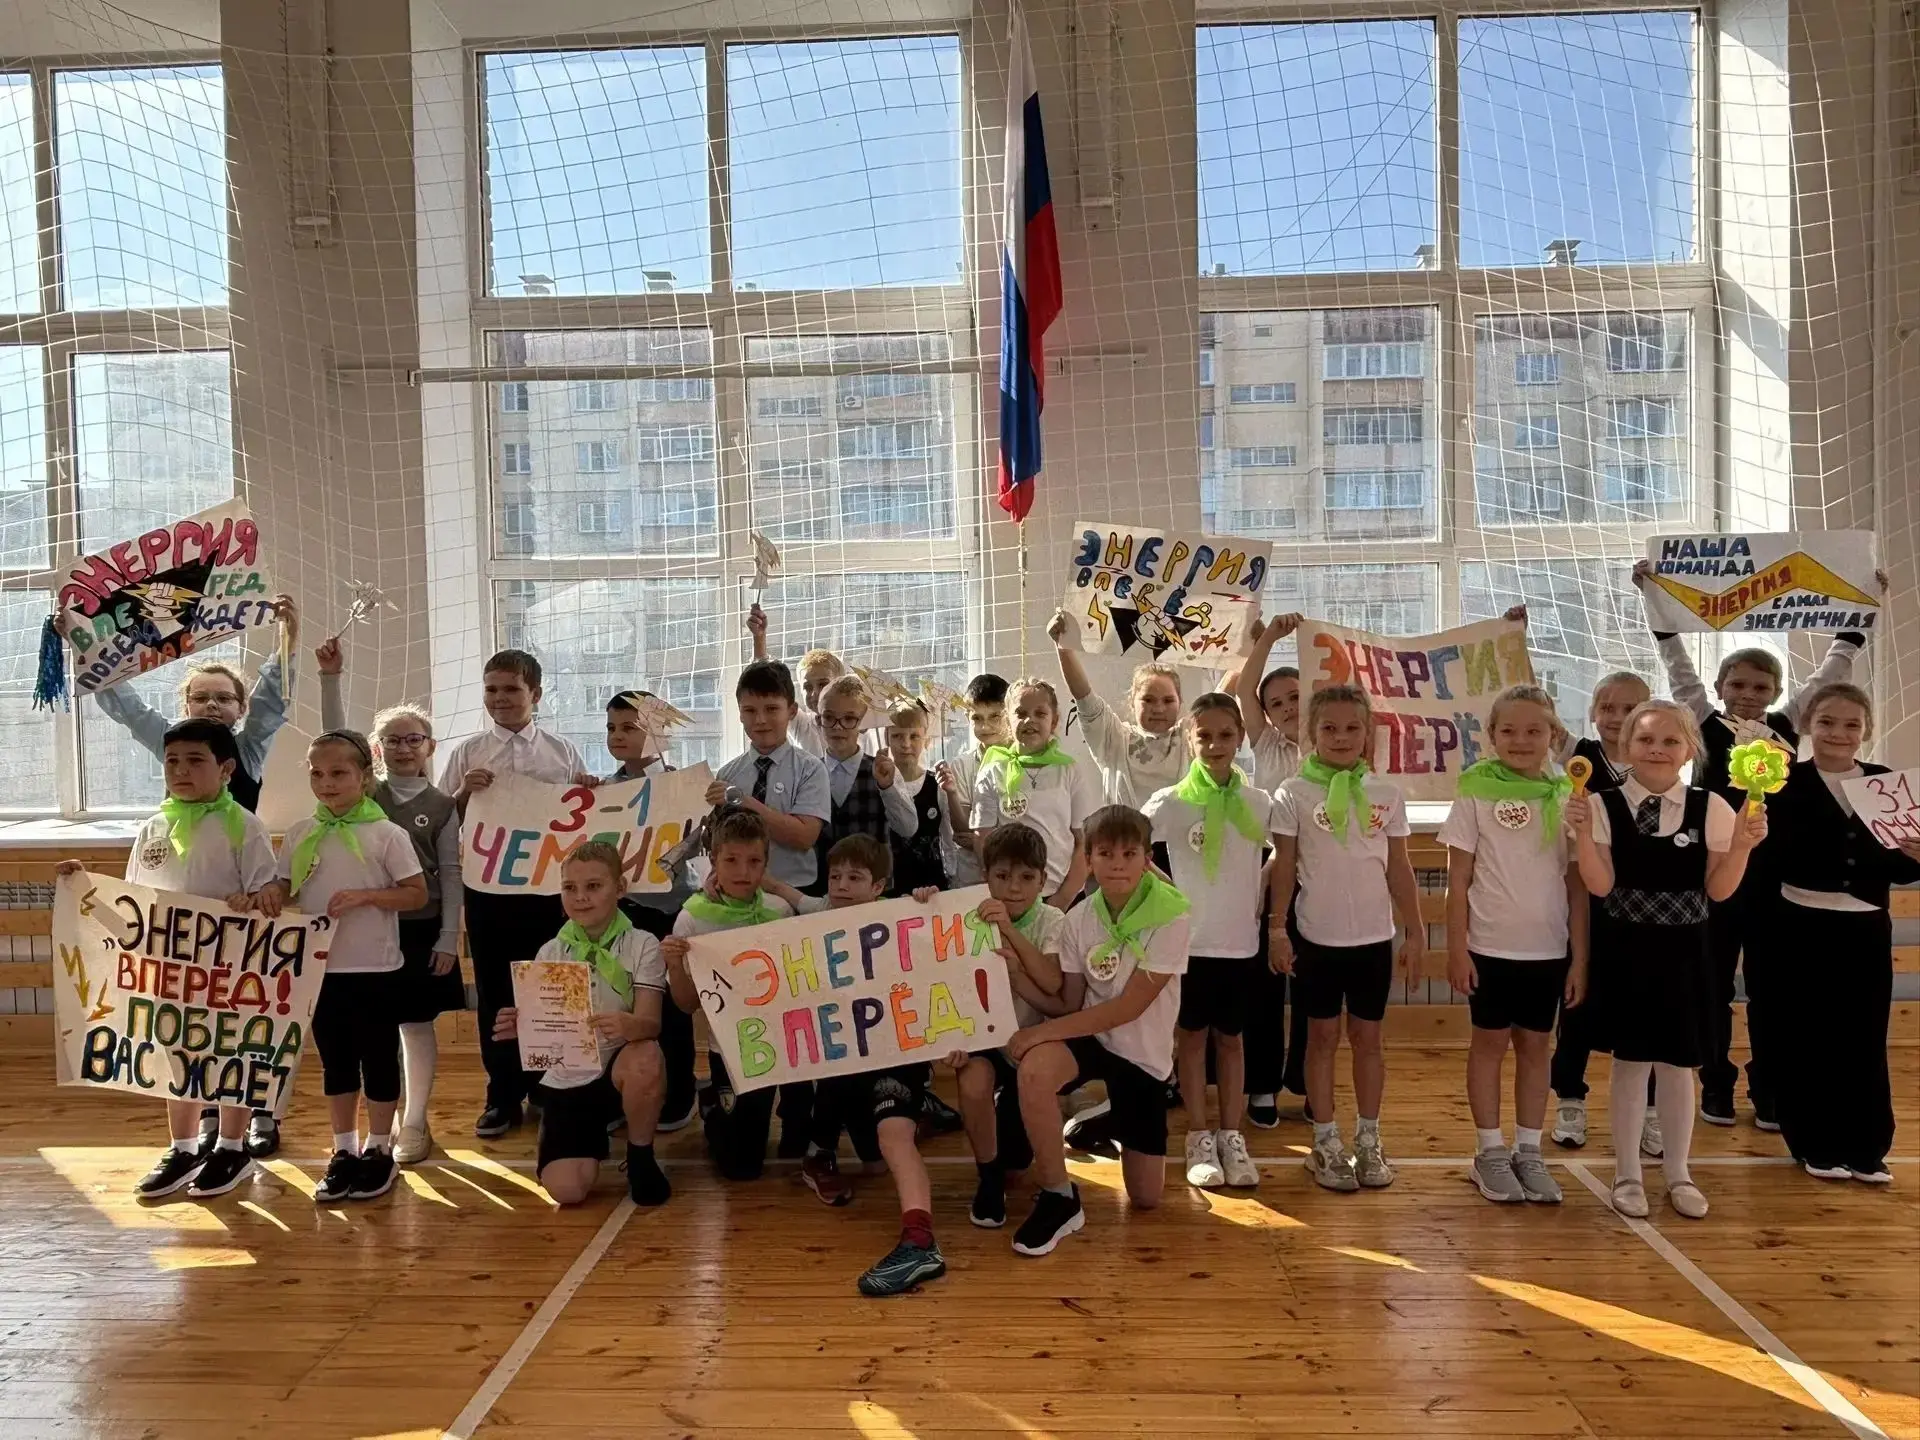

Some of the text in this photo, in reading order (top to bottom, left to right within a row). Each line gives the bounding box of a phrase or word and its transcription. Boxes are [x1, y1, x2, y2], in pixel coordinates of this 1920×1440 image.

[58, 518, 258, 616] ЭНЕРГИЯ
[1074, 530, 1265, 592] ЭНЕРГИЯ
[1655, 559, 1755, 577] КОМАНДА
[1662, 536, 1751, 560] НАША
[1698, 565, 1793, 618] ЭНЕРГИЯ
[1771, 595, 1830, 610] САМАЯ
[1743, 611, 1877, 631] ЭНЕРГИЧНАЯ
[1312, 630, 1526, 700] ЭНЕРГИЯ
[1366, 711, 1482, 774] ПЕРЁ
[549, 777, 651, 832] 3-1
[1866, 773, 1920, 813] 3-1
[117, 952, 291, 1015] ВПЕРЁД!
[731, 908, 996, 1006] ЭНЕРГИЯ
[700, 969, 732, 1013] 3-1
[81, 1025, 155, 1088] ВАС
[127, 996, 301, 1066] ПОБЕДА
